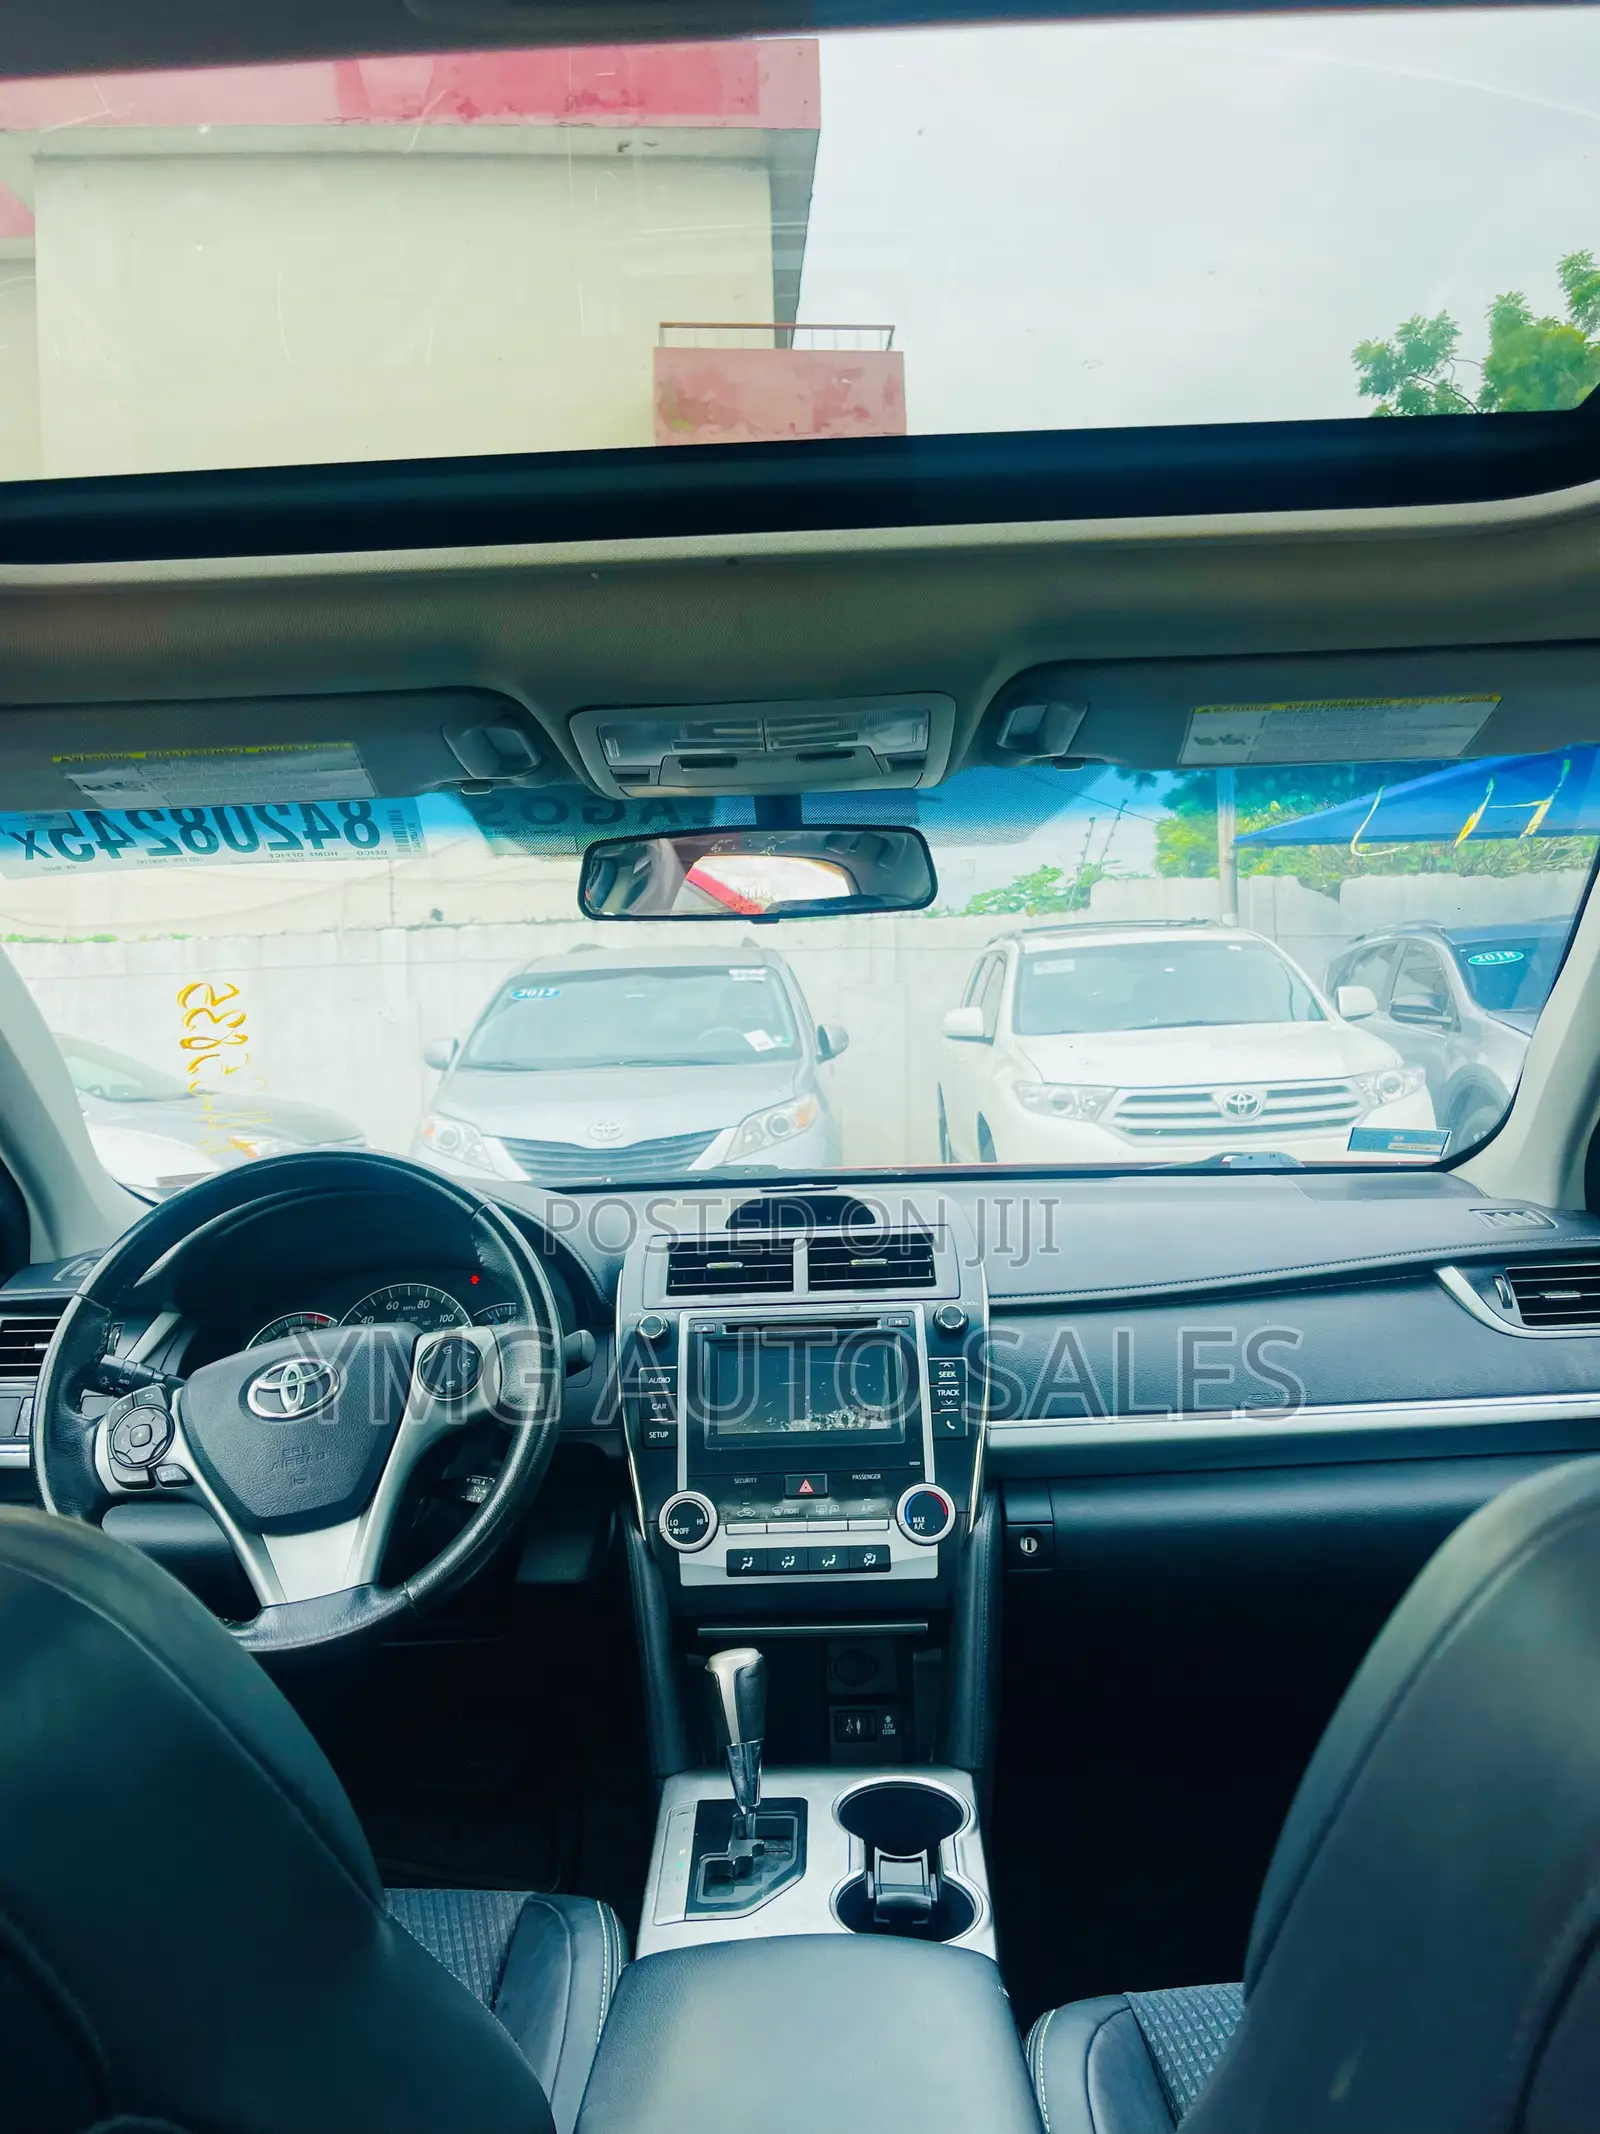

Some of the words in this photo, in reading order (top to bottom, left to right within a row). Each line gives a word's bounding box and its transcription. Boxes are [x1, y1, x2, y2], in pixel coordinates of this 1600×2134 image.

[1474, 951, 1516, 962] 2018
[385, 1301, 399, 1311] 60
[417, 1299, 430, 1310] 80
[360, 1315, 375, 1325] 40
[439, 1313, 455, 1323] 100
[938, 1370, 956, 1378] SEEK
[648, 1376, 671, 1384] AUDIO
[936, 1389, 960, 1397] TRACK
[648, 1430, 669, 1439] SETUP
[733, 1476, 758, 1484] SECURITY
[851, 1473, 882, 1481] PASSENGER
[669, 1518, 679, 1527] LO
[696, 1517, 704, 1526] HI
[912, 1516, 926, 1524] MAX
[679, 1527, 690, 1535] OFF
[913, 1523, 925, 1531] A/C
